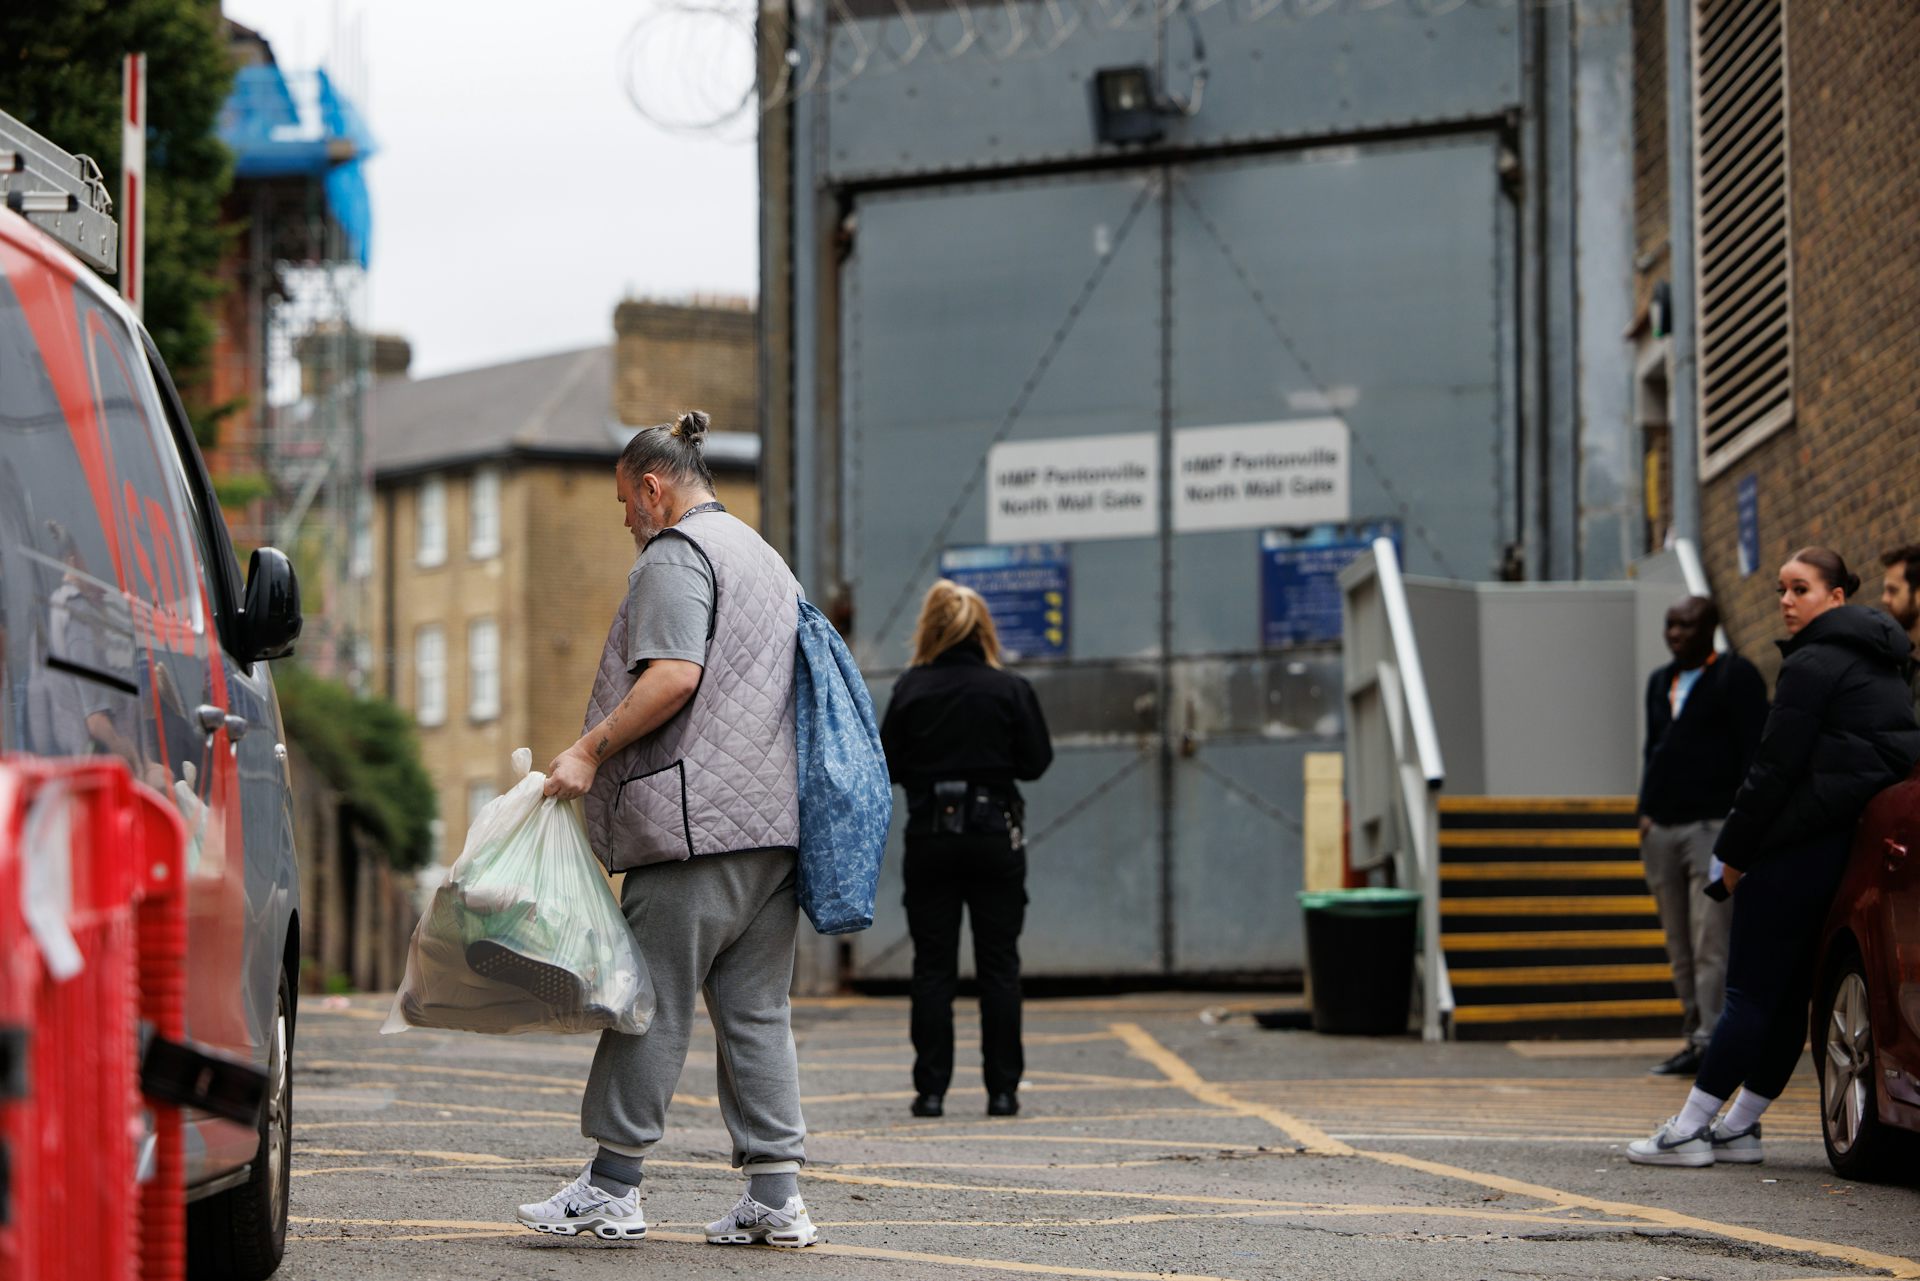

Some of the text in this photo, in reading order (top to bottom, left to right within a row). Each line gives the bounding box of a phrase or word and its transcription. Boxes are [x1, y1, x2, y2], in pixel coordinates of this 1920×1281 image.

[1000, 495, 1050, 516] North
[1102, 488, 1146, 511] Gate
[1185, 482, 1237, 503] North
[1290, 474, 1336, 497] Gate
